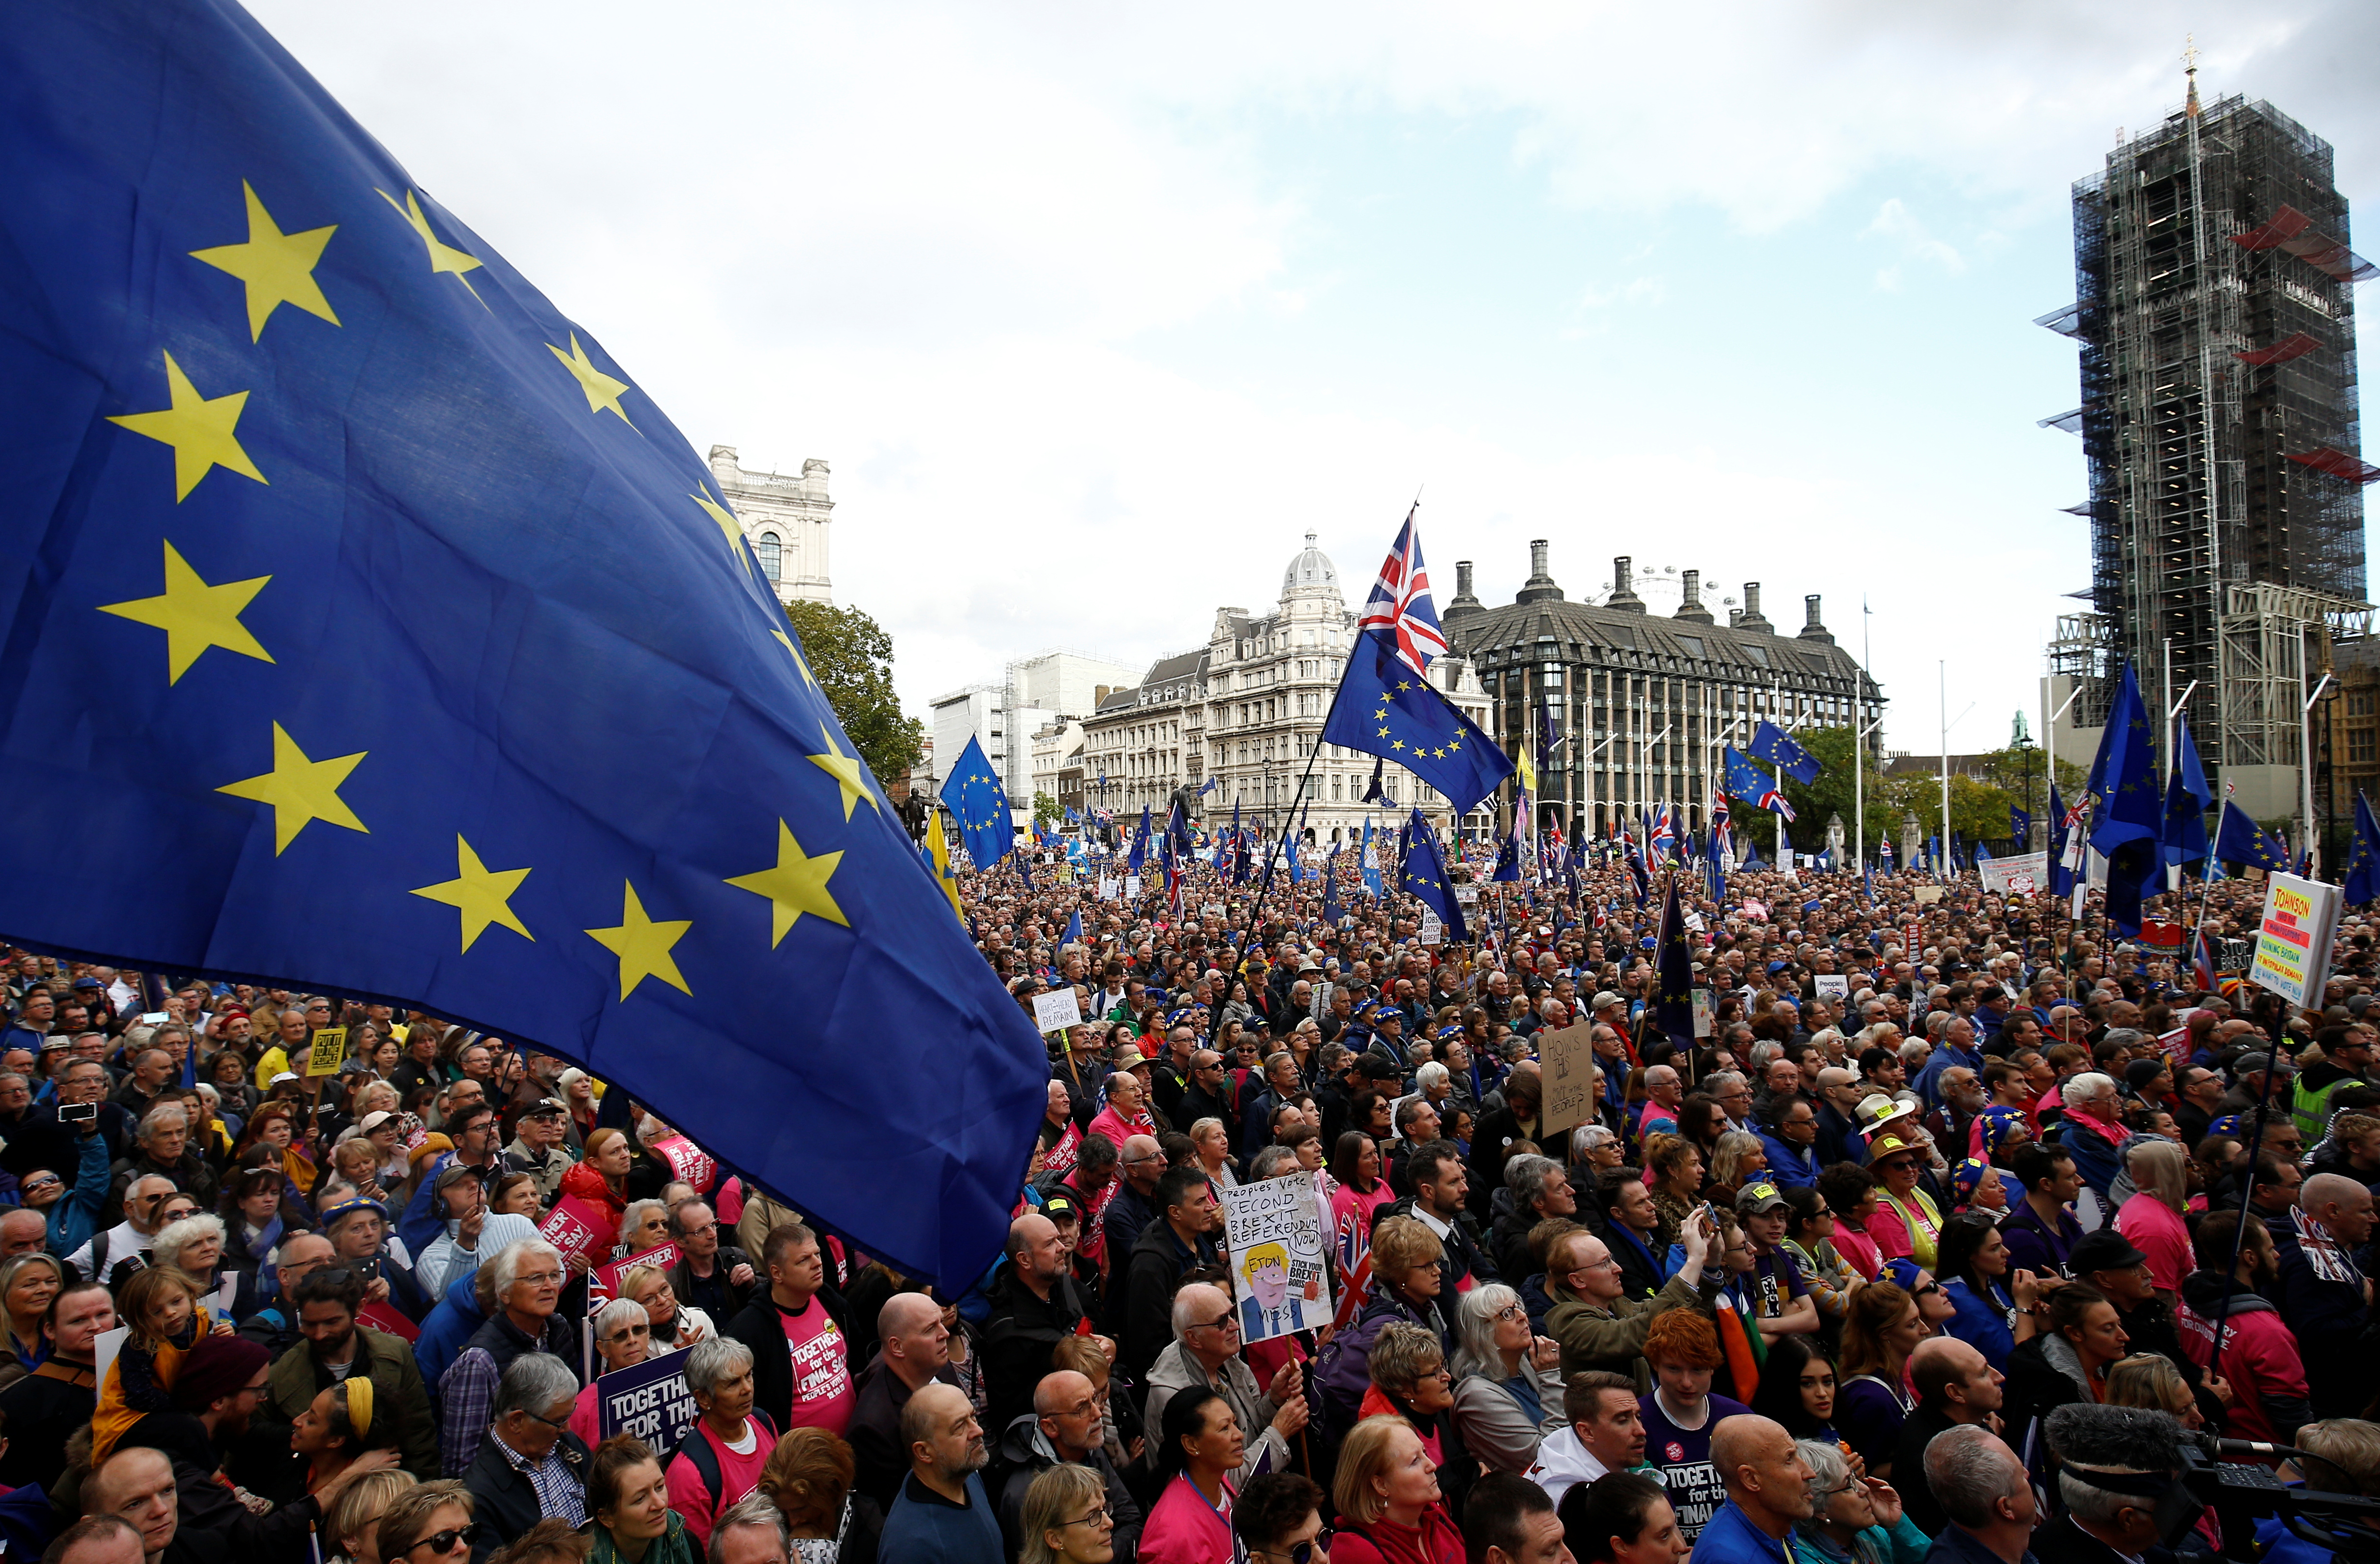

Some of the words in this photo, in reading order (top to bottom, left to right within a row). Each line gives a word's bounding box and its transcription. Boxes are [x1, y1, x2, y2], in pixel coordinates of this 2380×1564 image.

[2274, 888, 2310, 918] JOHNSON
[2220, 941, 2249, 957] STOP
[2281, 947, 2300, 964] BRITAIN
[2220, 954, 2252, 971] BREXIT
[2284, 965, 2303, 982] DEMAND
[2280, 980, 2291, 992] VOTE
[1039, 1003, 1053, 1015] HEART
[1058, 999, 1071, 1010] HEAD
[1042, 1010, 1073, 1027] REMAIN
[316, 1035, 332, 1046] PUT
[333, 1034, 341, 1045] IT
[1547, 1035, 1581, 1058] HOW'S
[316, 1046, 325, 1055] TO
[326, 1045, 339, 1055] THE
[313, 1055, 338, 1064] PEOPLE
[1553, 1056, 1570, 1072] THIS
[684, 1142, 701, 1157] SAY
[684, 1152, 693, 1165] the
[1046, 1134, 1074, 1167] TOGETHER
[669, 1147, 688, 1180] GETHER
[1059, 1156, 1068, 1167] for
[695, 1157, 704, 1185] FINAL
[1279, 1177, 1306, 1190] Vote
[1229, 1194, 1294, 1217] SECOND
[542, 1212, 569, 1240] THER
[1231, 1208, 1298, 1232] BREXIT
[564, 1224, 584, 1248] SAY
[1232, 1219, 1318, 1244] REFERENDUM
[579, 1233, 595, 1251] MARCH
[1294, 1233, 1319, 1249] NOW!
[1248, 1255, 1280, 1273] ETON
[1292, 1259, 1307, 1269] STICK
[1308, 1262, 1323, 1271] YOUR
[1288, 1278, 1306, 1288] BORIS
[1258, 1304, 1297, 1324] MESS
[791, 1333, 841, 1366] TOGETHER
[809, 1357, 822, 1370] for
[822, 1349, 836, 1362] the
[801, 1365, 833, 1392] FINAL
[832, 1353, 846, 1373] SAY
[611, 1375, 690, 1420] TOGETHE
[802, 1384, 831, 1402] PEOPLE'S
[830, 1377, 843, 1388] VOTE
[827, 1383, 846, 1400] 19.10.19
[622, 1410, 661, 1439] FOR
[1688, 1488, 1709, 1503] for
[1711, 1485, 1727, 1500] th
